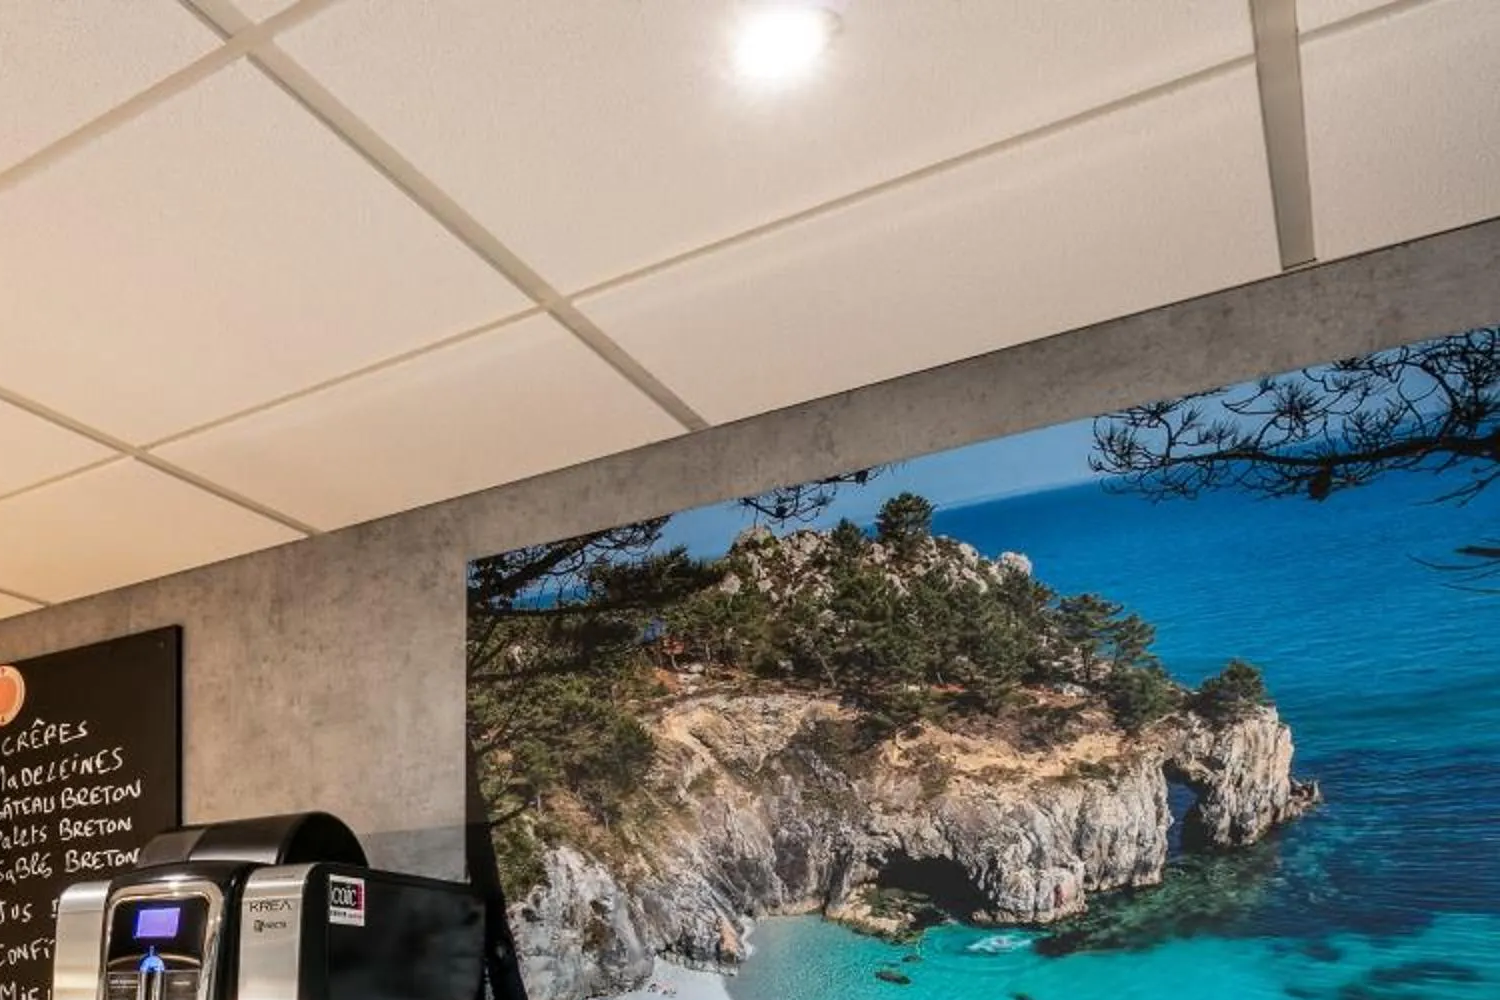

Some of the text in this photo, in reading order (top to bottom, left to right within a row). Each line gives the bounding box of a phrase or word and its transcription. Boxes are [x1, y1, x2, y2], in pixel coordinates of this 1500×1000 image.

[1, 718, 88, 756] CRÊPES
[61, 779, 141, 809] BRETON
[59, 816, 133, 841] BRETON
[64, 847, 141, 873] BRETON
